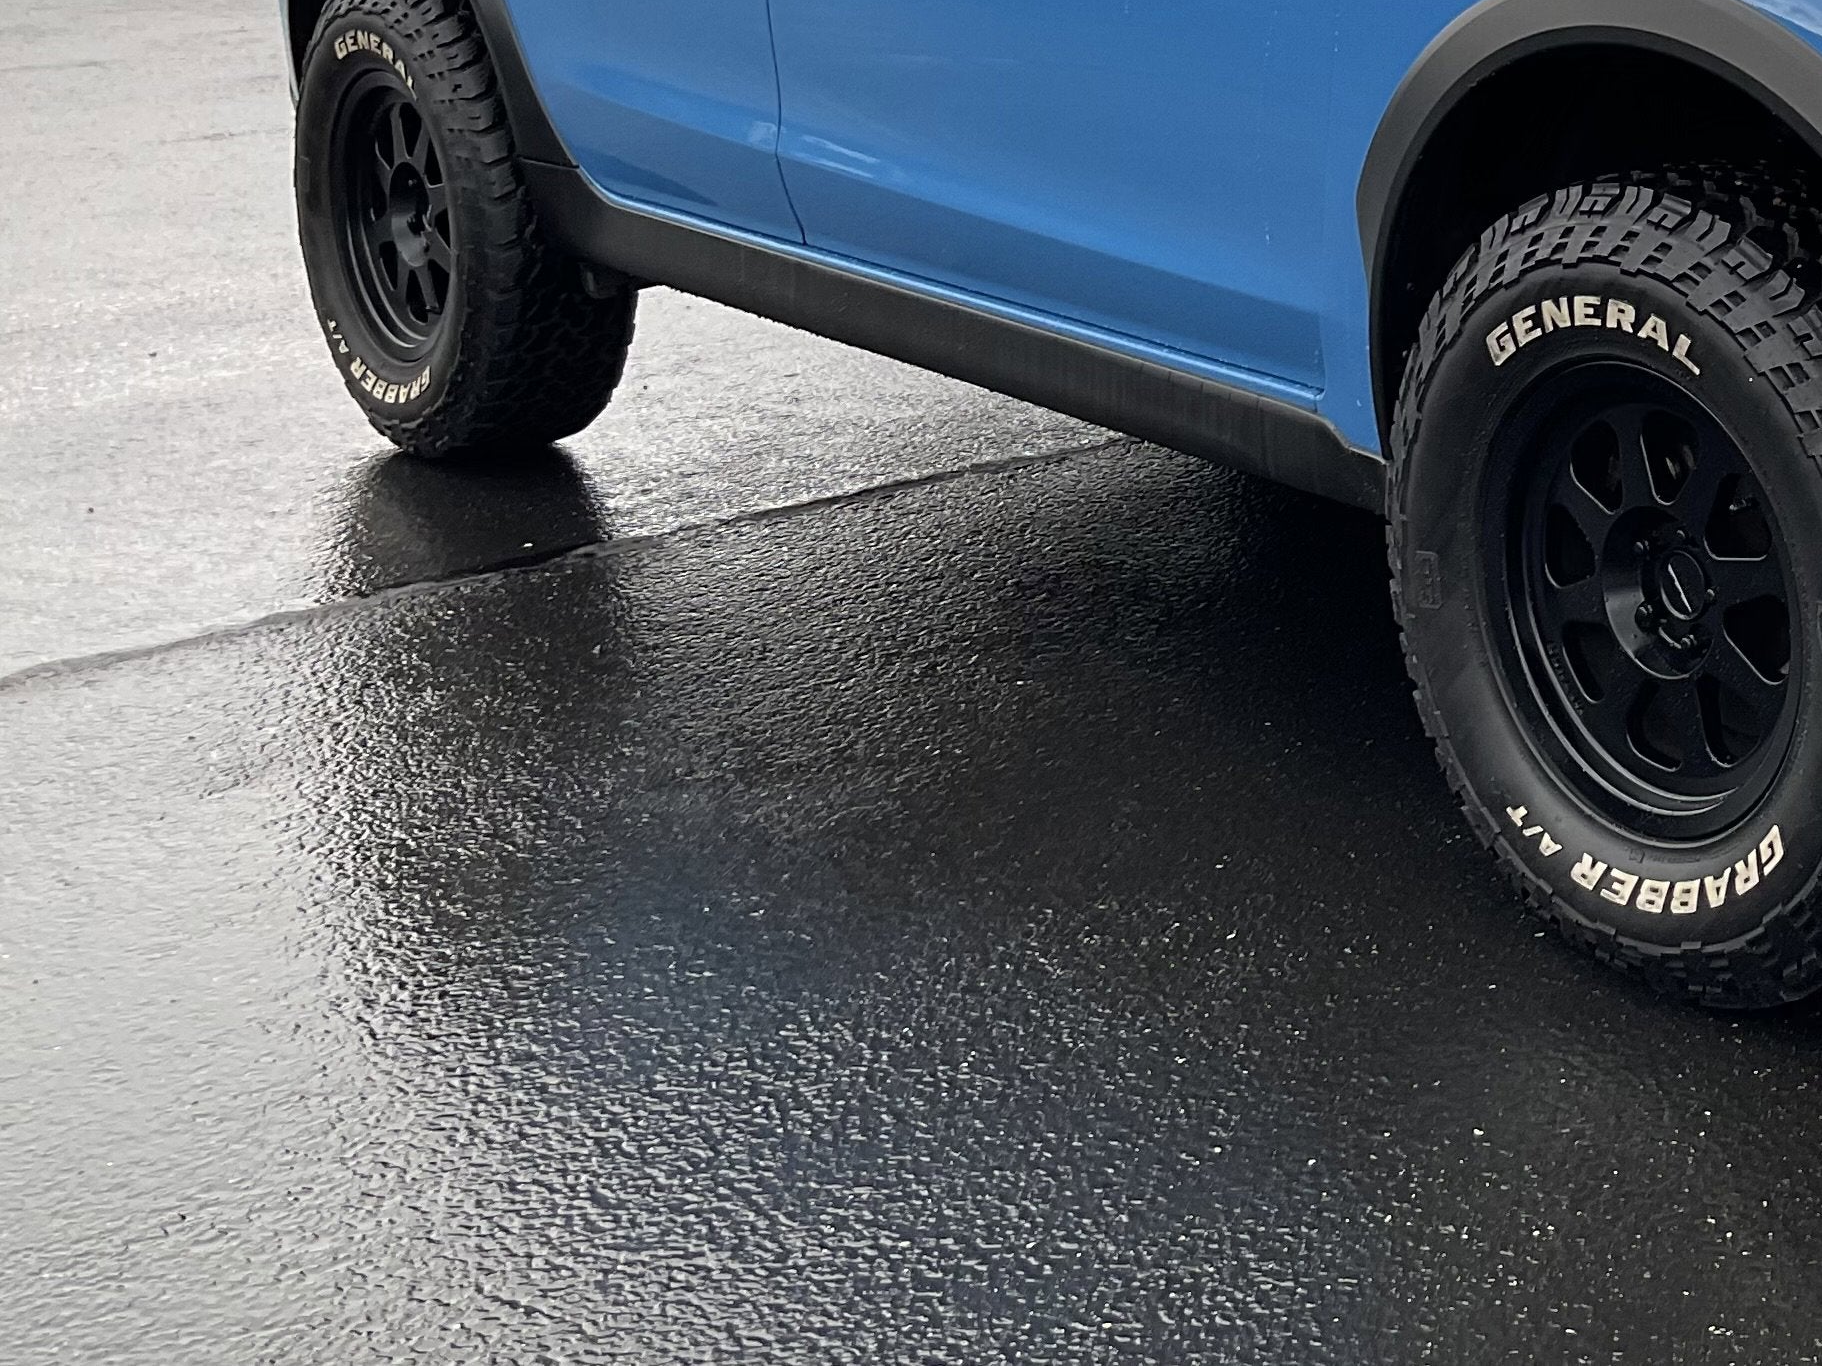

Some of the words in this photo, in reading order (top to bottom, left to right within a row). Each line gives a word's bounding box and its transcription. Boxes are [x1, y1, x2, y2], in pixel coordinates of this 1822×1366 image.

[334, 28, 417, 102] GENERAL
[1485, 295, 1701, 376] GENERAL
[350, 356, 431, 404] GRABBER
[1506, 805, 1563, 856] A/T
[1570, 824, 1785, 914] GRABBER
